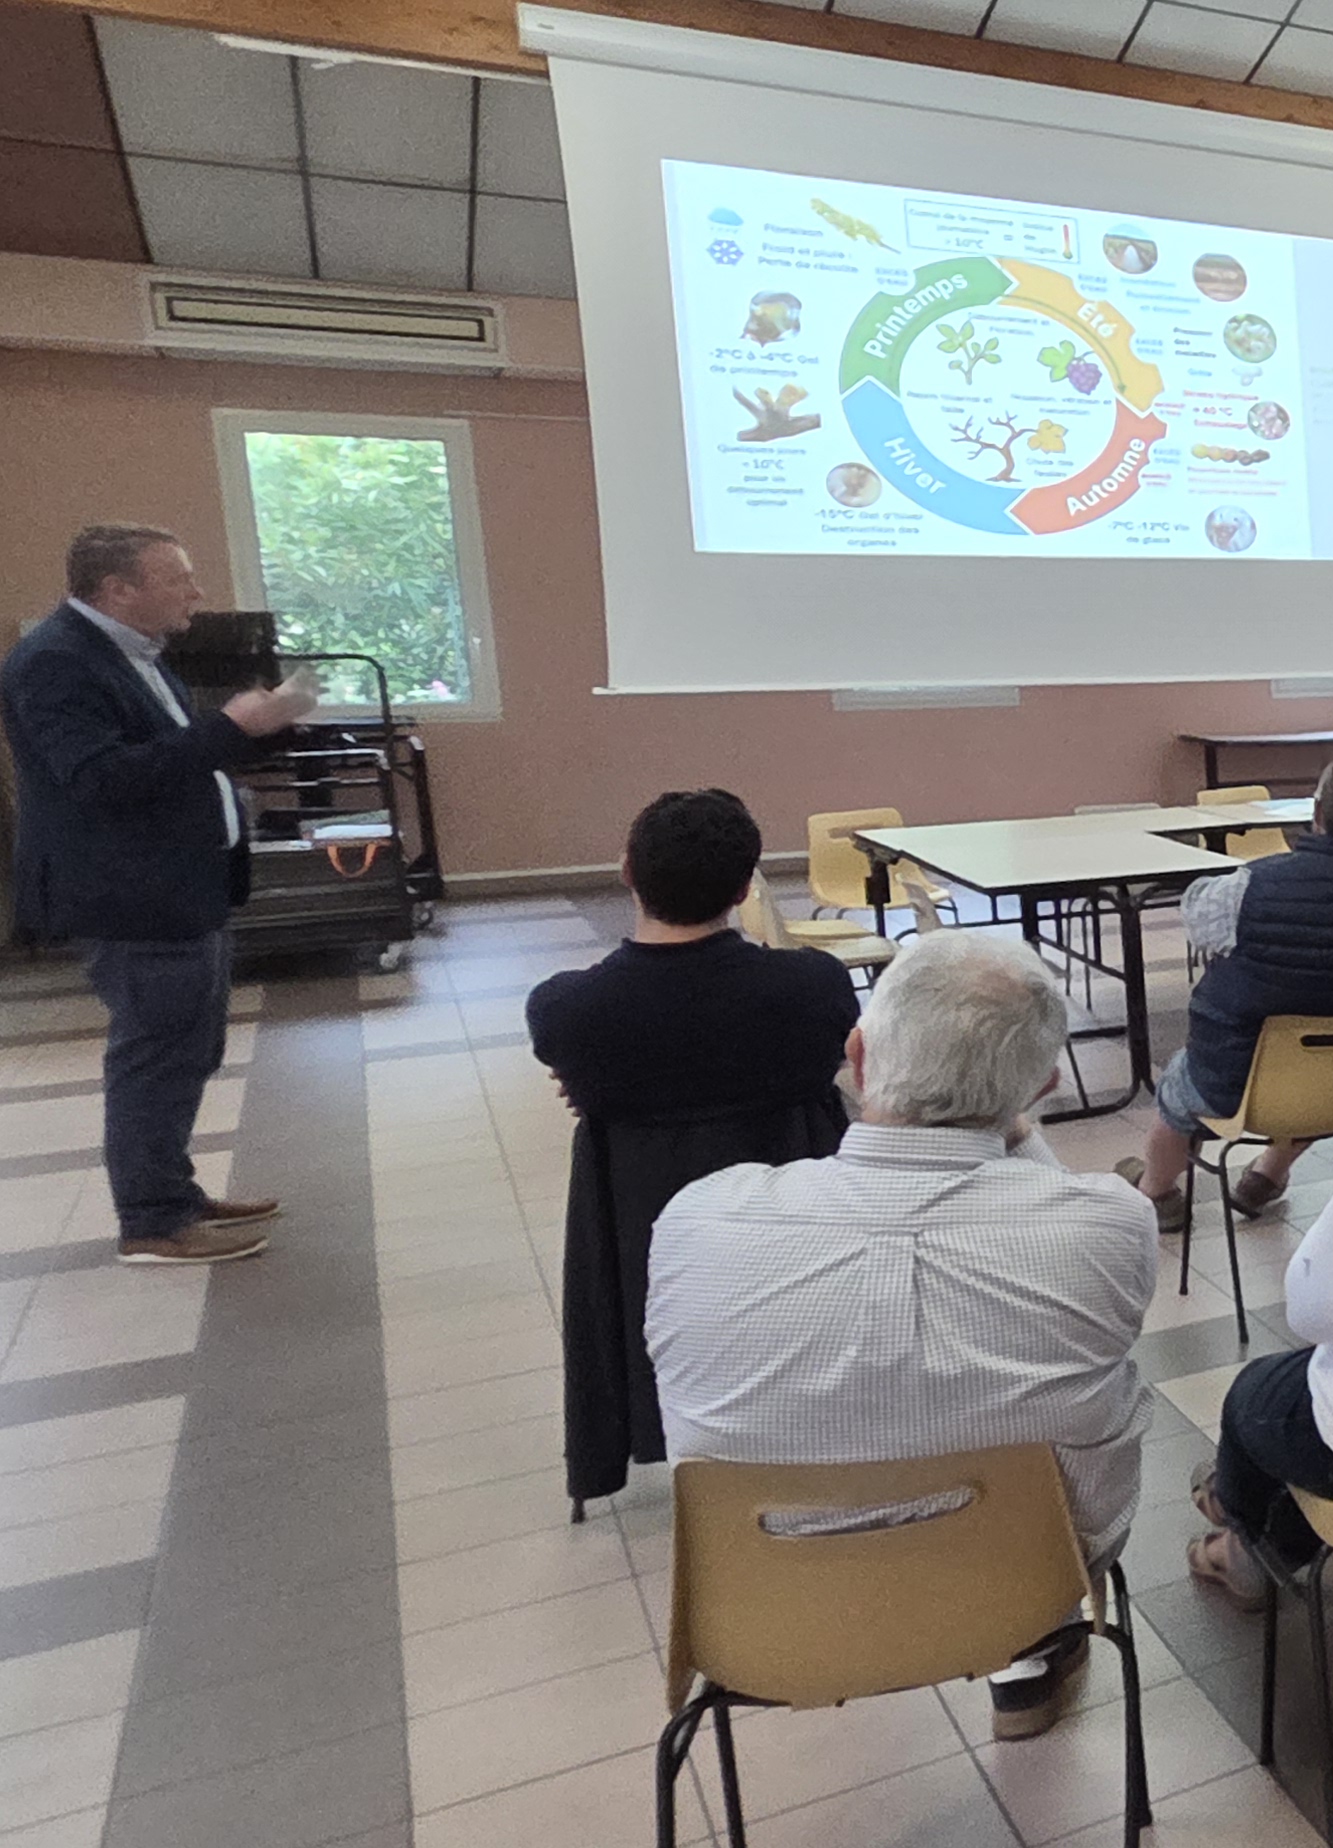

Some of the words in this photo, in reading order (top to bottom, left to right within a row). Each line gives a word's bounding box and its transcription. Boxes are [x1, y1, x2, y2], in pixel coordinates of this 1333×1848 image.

[863, 272, 968, 358] Printemps
[1077, 299, 1118, 338] Été
[884, 437, 947, 494] Hiver
[1066, 437, 1147, 516] Automne
